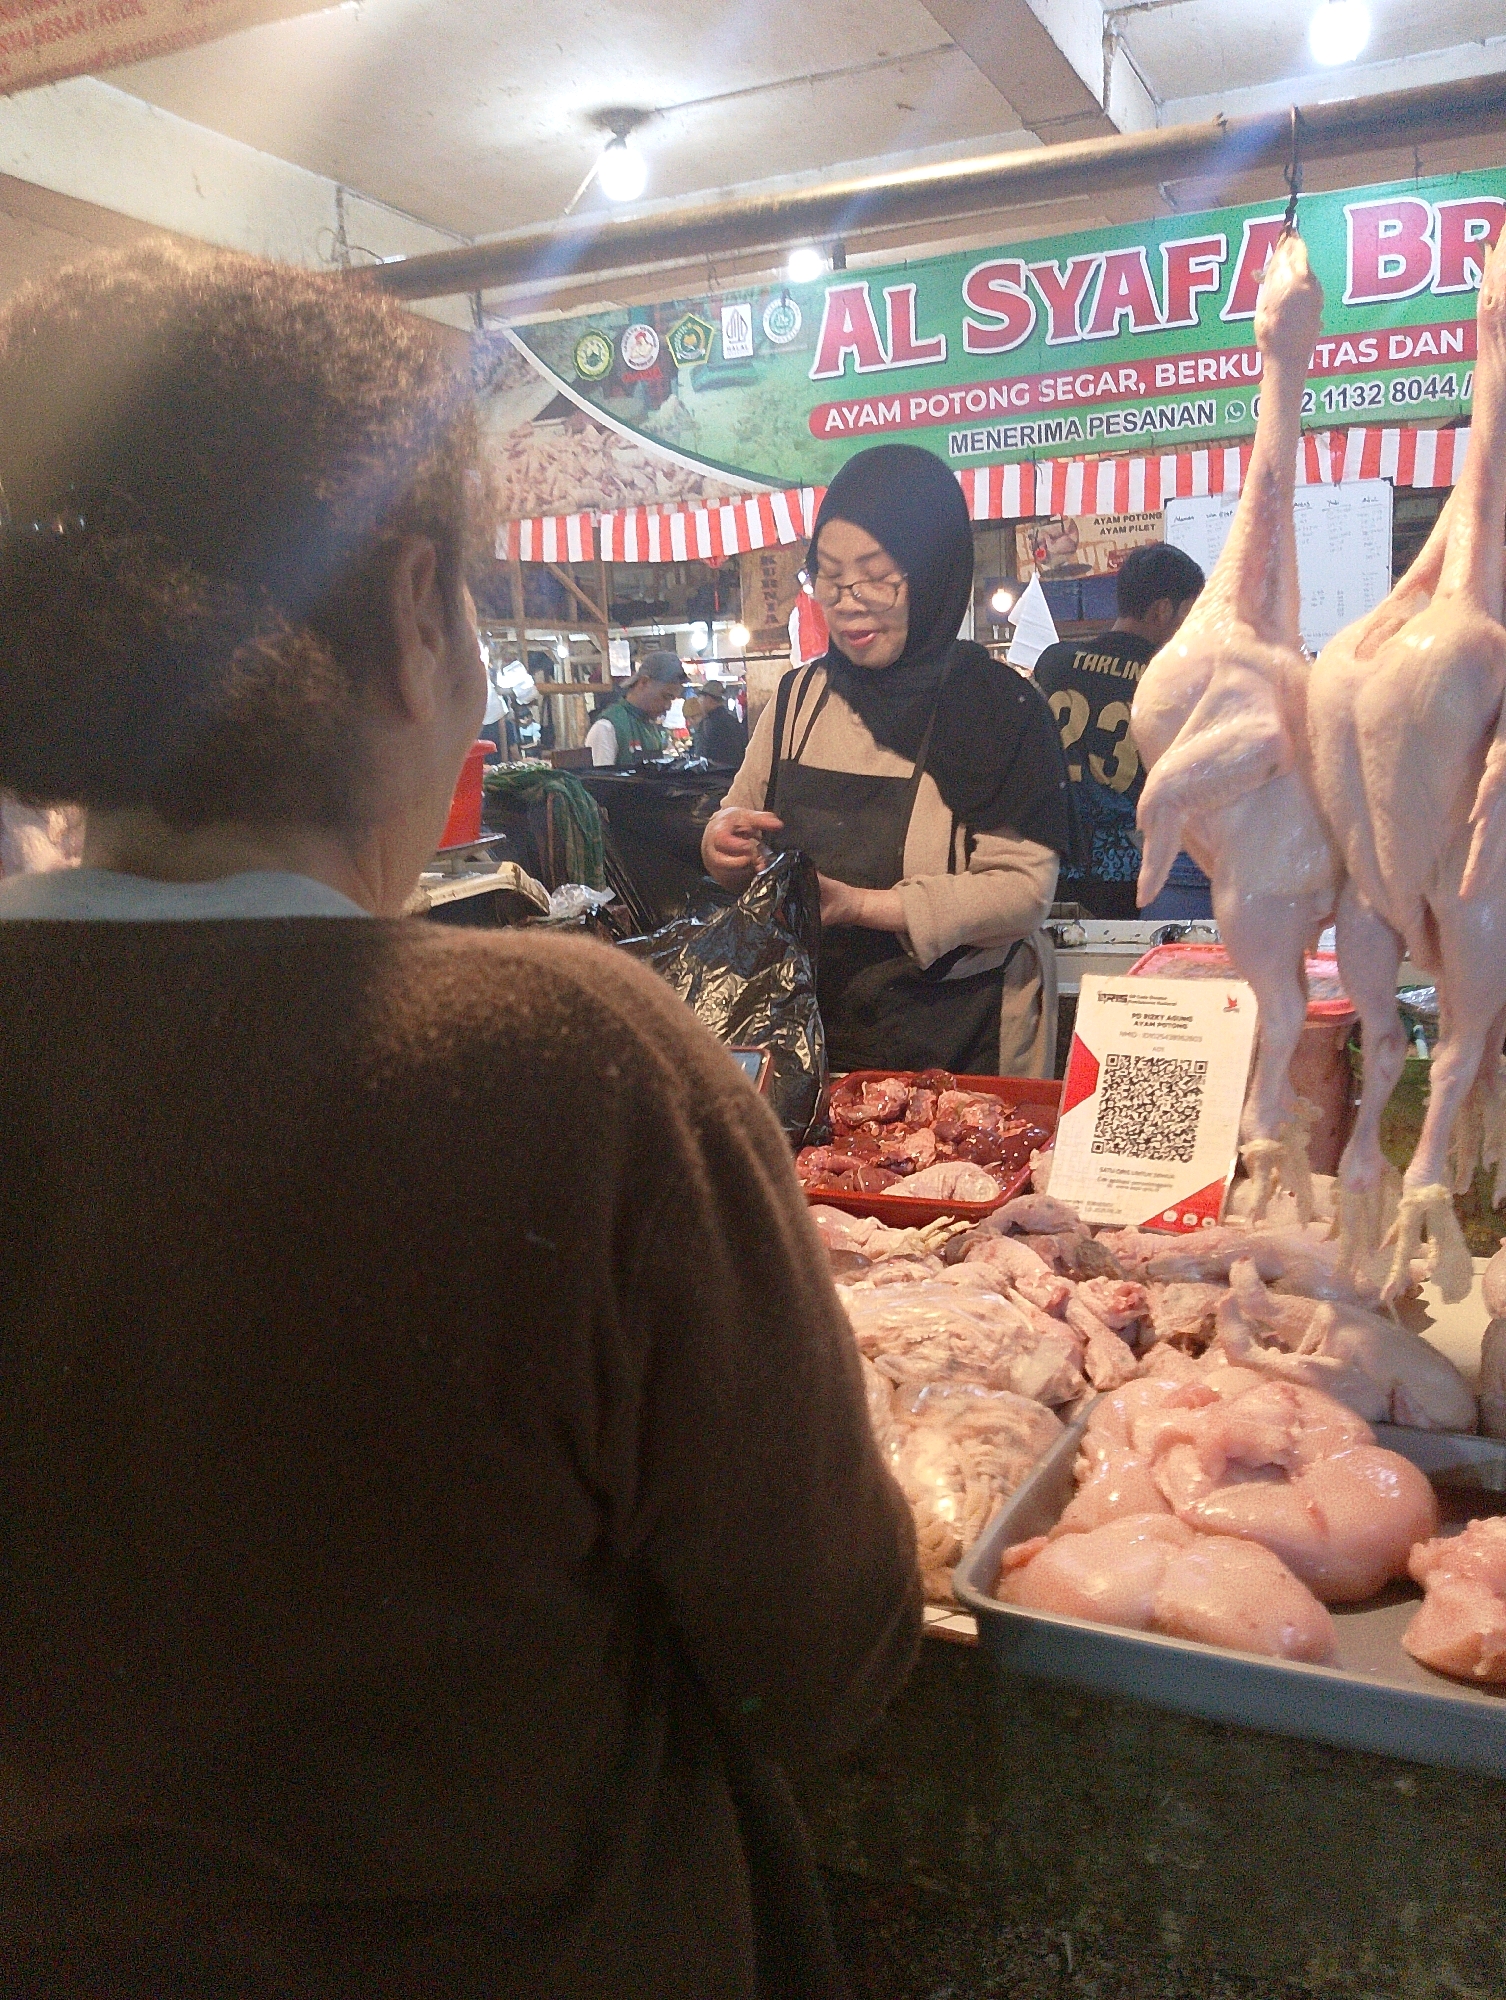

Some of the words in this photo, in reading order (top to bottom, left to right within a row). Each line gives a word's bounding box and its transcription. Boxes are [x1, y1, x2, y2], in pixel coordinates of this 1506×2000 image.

[808, 281, 947, 381] AL
[962, 213, 1298, 355] SYAFA
[824, 399, 901, 432] AYAM
[909, 382, 1030, 421] POTONG
[1038, 368, 1146, 403] SEGAR,
[1155, 338, 1377, 388] BERKUTAS
[1388, 327, 1464, 360] DAN
[951, 420, 1082, 454] MENERIMA
[1088, 402, 1214, 437] PESANAN
[1323, 383, 1382, 410] 1132
[1391, 375, 1456, 403] 8044
[1093, 516, 1121, 526] AYAM
[1122, 511, 1163, 521] POTONG
[1100, 525, 1127, 536] AYAM
[1048, 689, 1139, 794] 23
